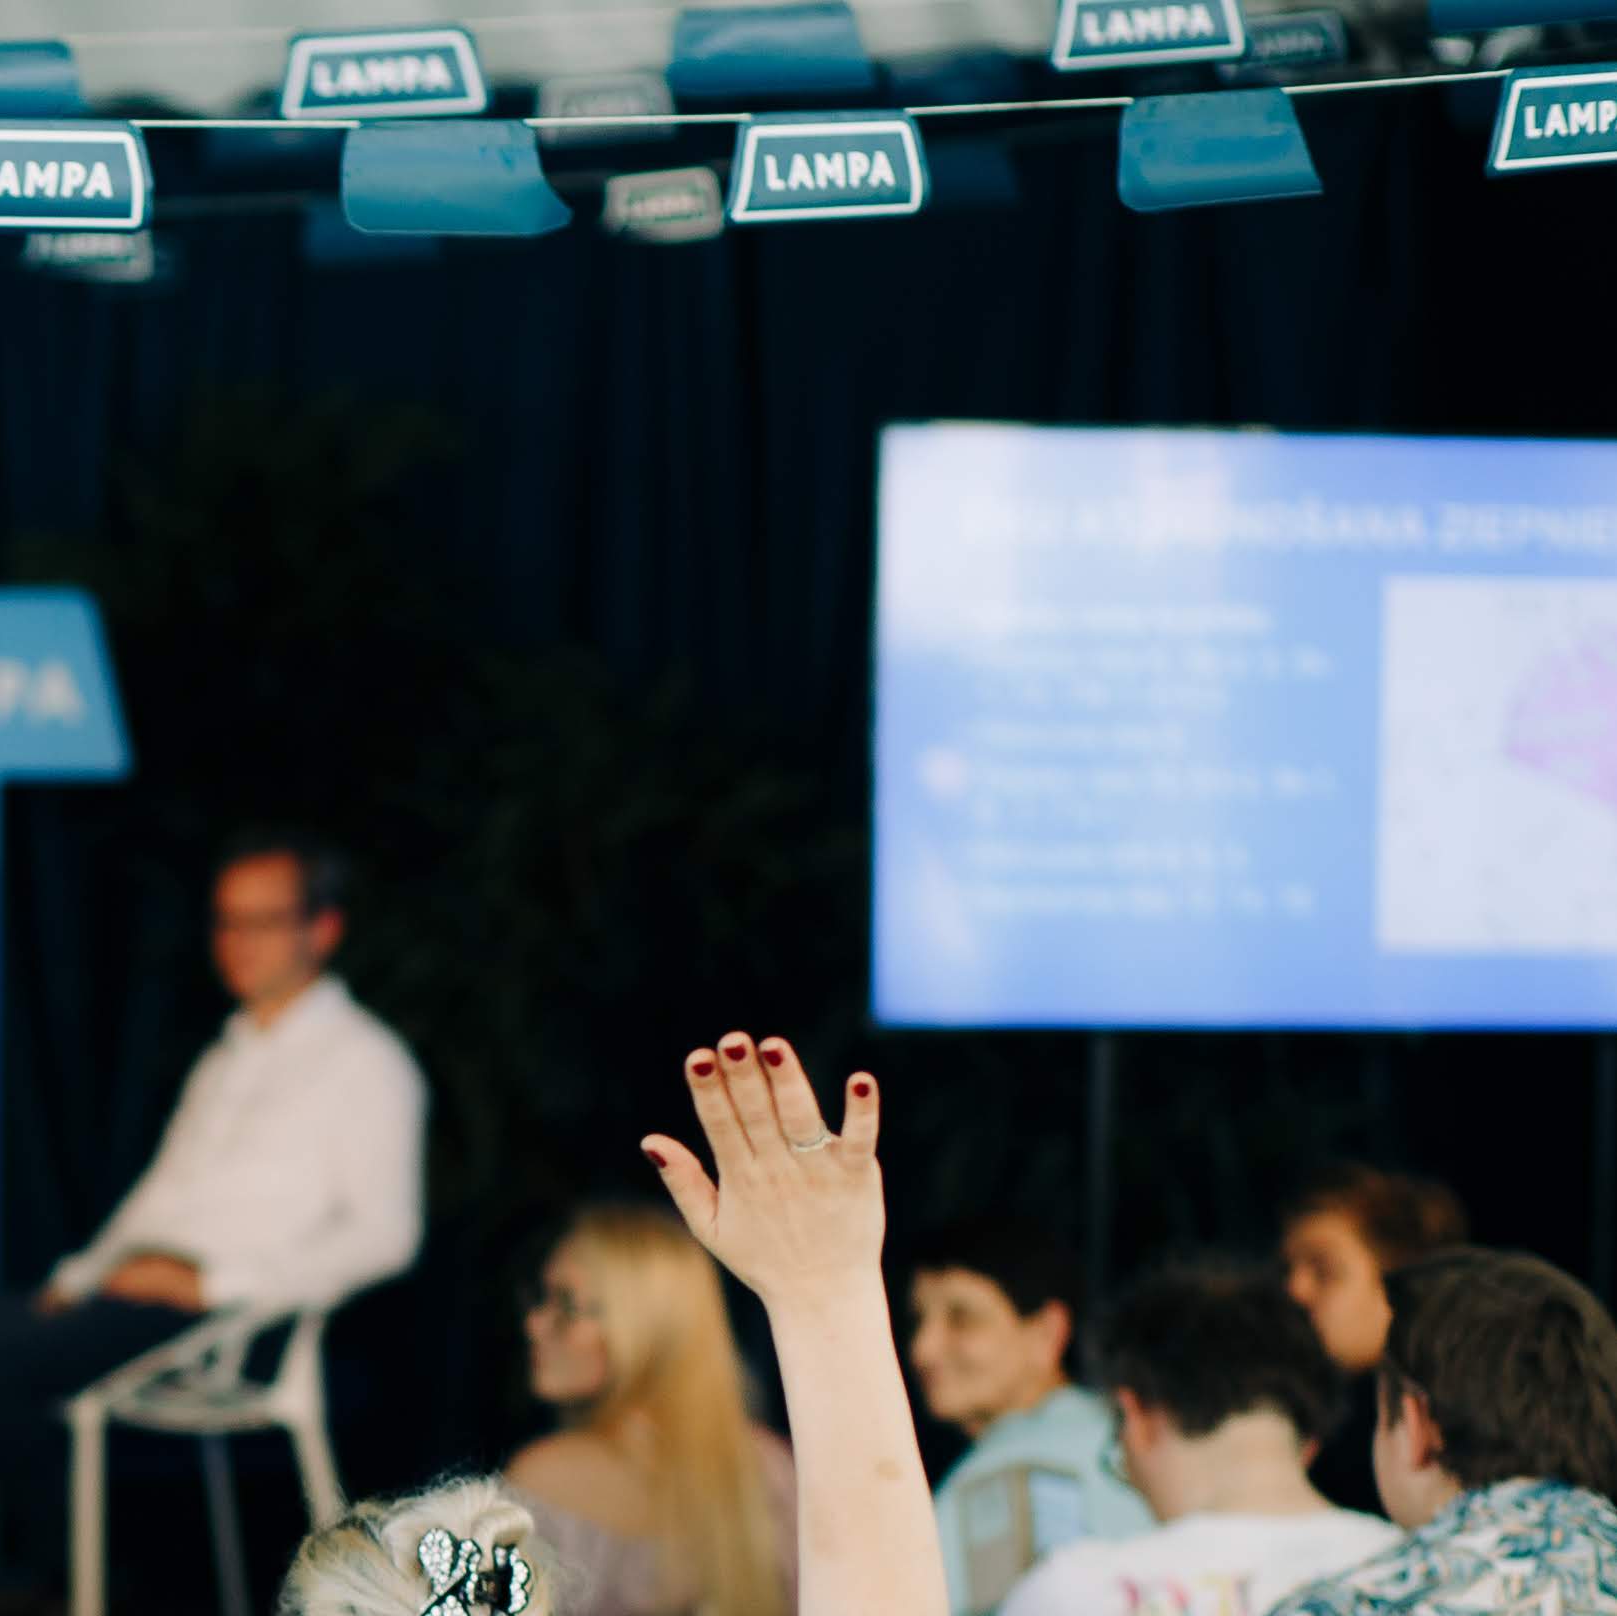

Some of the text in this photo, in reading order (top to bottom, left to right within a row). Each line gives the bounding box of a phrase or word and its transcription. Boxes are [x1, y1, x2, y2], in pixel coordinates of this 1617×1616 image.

[1080, 3, 1215, 46] LAMPA
[313, 54, 453, 98] LAMPA
[1524, 99, 1617, 139] LAMP
[765, 150, 896, 192] LAMPA
